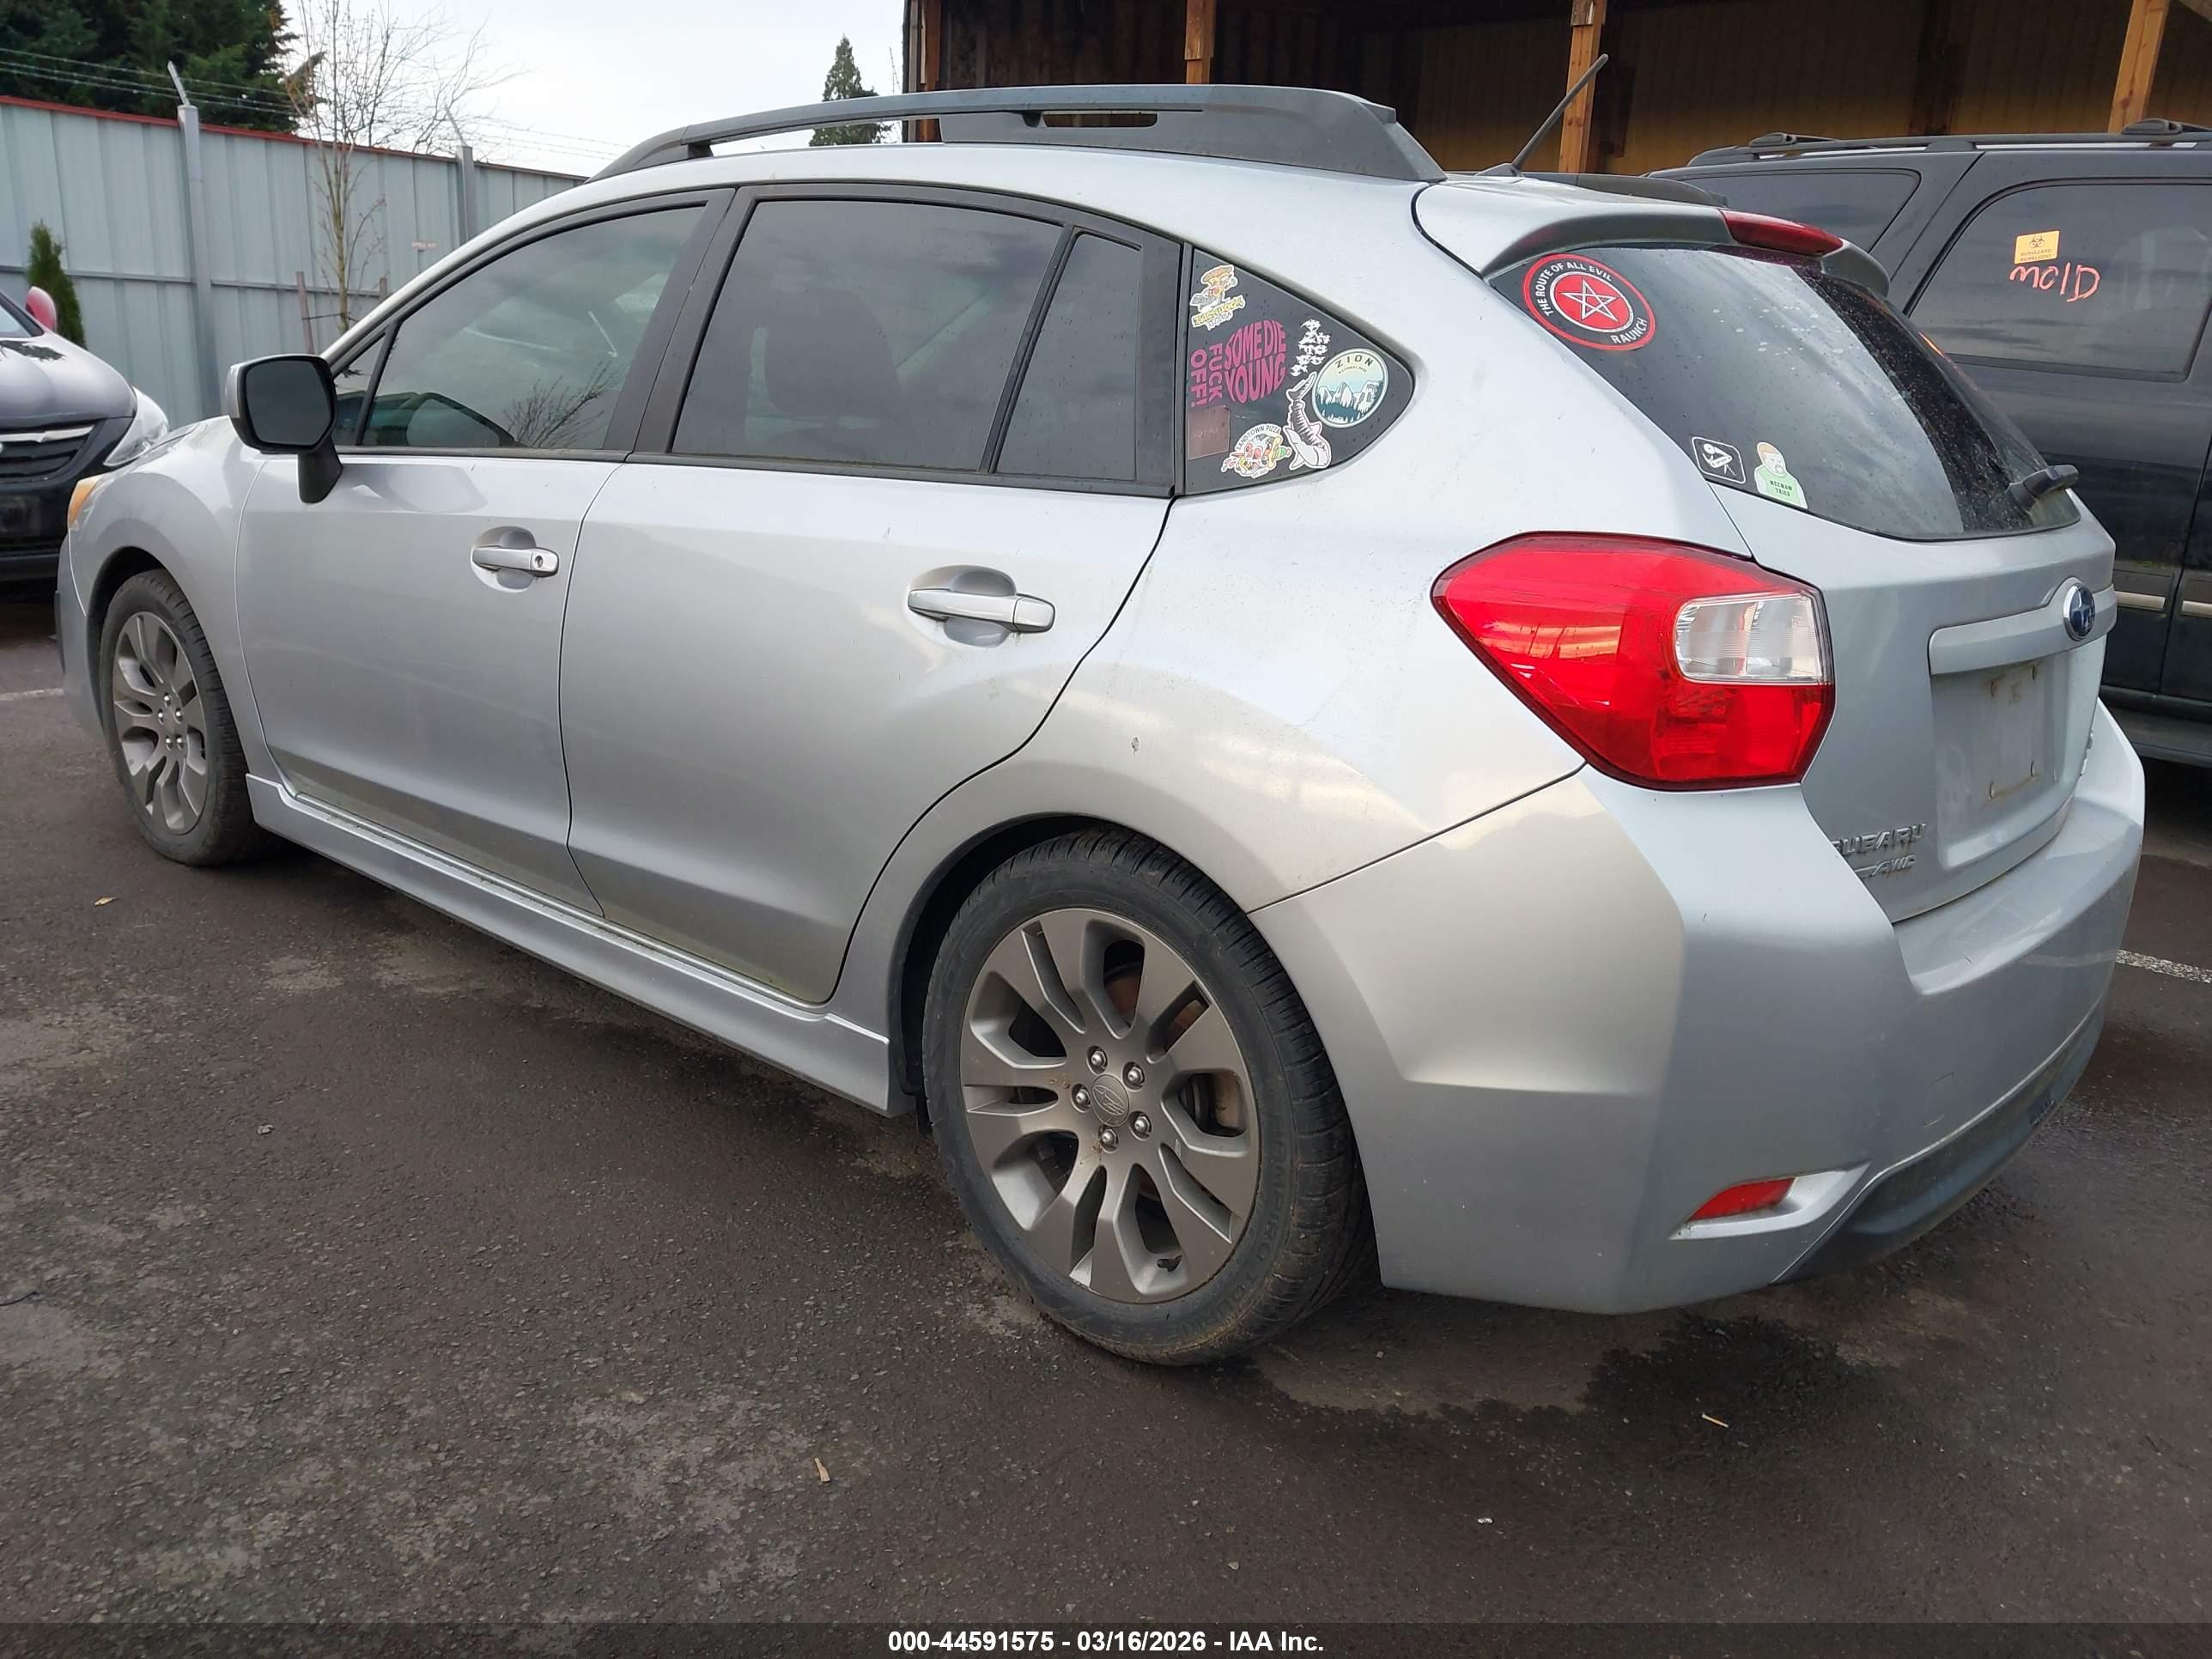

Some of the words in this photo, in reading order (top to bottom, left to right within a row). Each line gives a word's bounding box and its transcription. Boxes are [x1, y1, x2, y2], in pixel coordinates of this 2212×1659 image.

[1551, 262, 1565, 272] OF
[1566, 261, 1588, 270] ALL
[1589, 265, 1613, 282] EVIL
[1535, 269, 1553, 296] ROUTE
[1537, 297, 1554, 317] THE
[1610, 317, 1649, 344] RAUNCH
[1224, 321, 1262, 370] SOME
[1263, 319, 1286, 356] DIE
[1208, 343, 1223, 403] FUCK
[1334, 354, 1374, 368] ZION
[1190, 349, 1207, 408] OFF!
[1224, 352, 1286, 404] YOUNG
[1266, 424, 1280, 434] PIZZA
[1831, 823, 1927, 854] SUBARU
